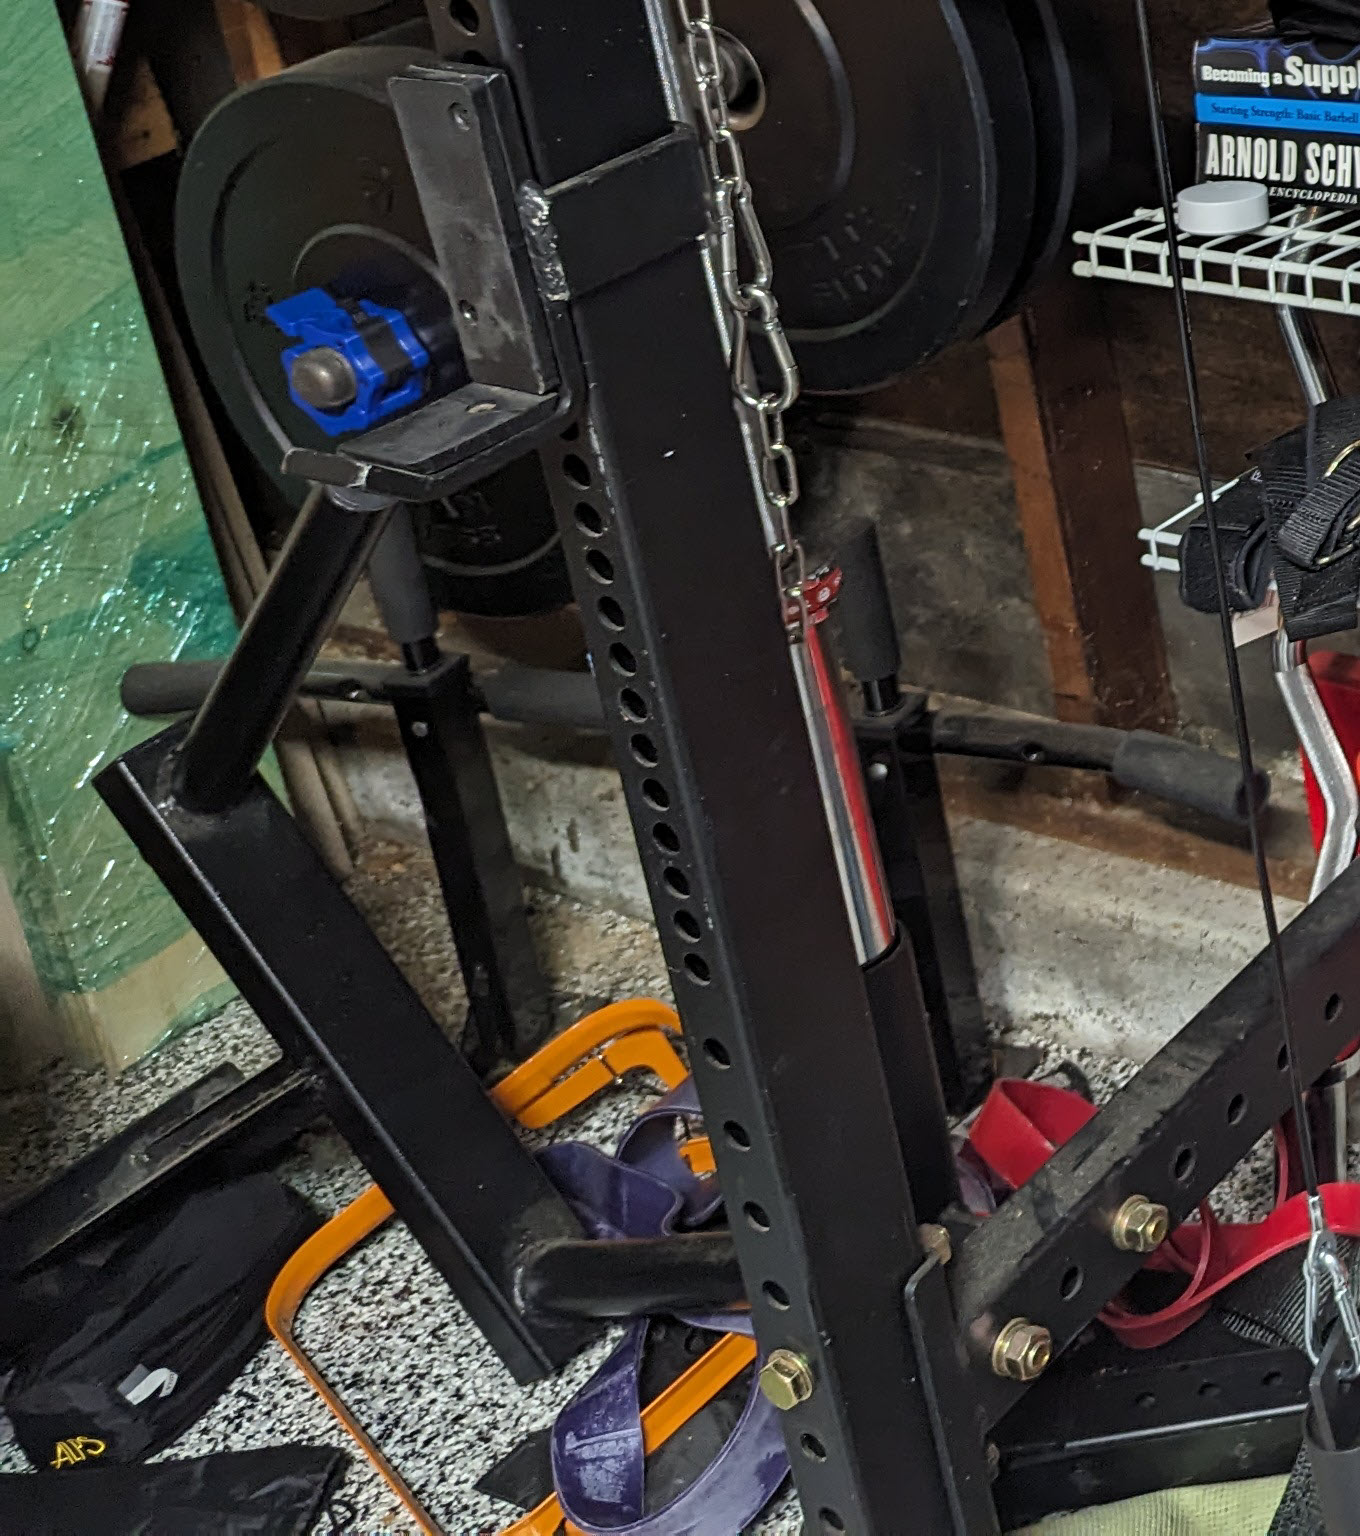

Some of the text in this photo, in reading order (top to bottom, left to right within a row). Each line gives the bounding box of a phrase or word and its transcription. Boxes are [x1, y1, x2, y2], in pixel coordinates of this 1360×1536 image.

[1201, 65, 1270, 88] Becoming
[1272, 71, 1283, 85] a
[1211, 103, 1249, 119] Starting
[1296, 108, 1321, 121] Basic
[1323, 110, 1359, 124] Barbell
[1204, 133, 1298, 183] ARNOLD
[1269, 186, 1359, 205] ENCYCLOPEDIA
